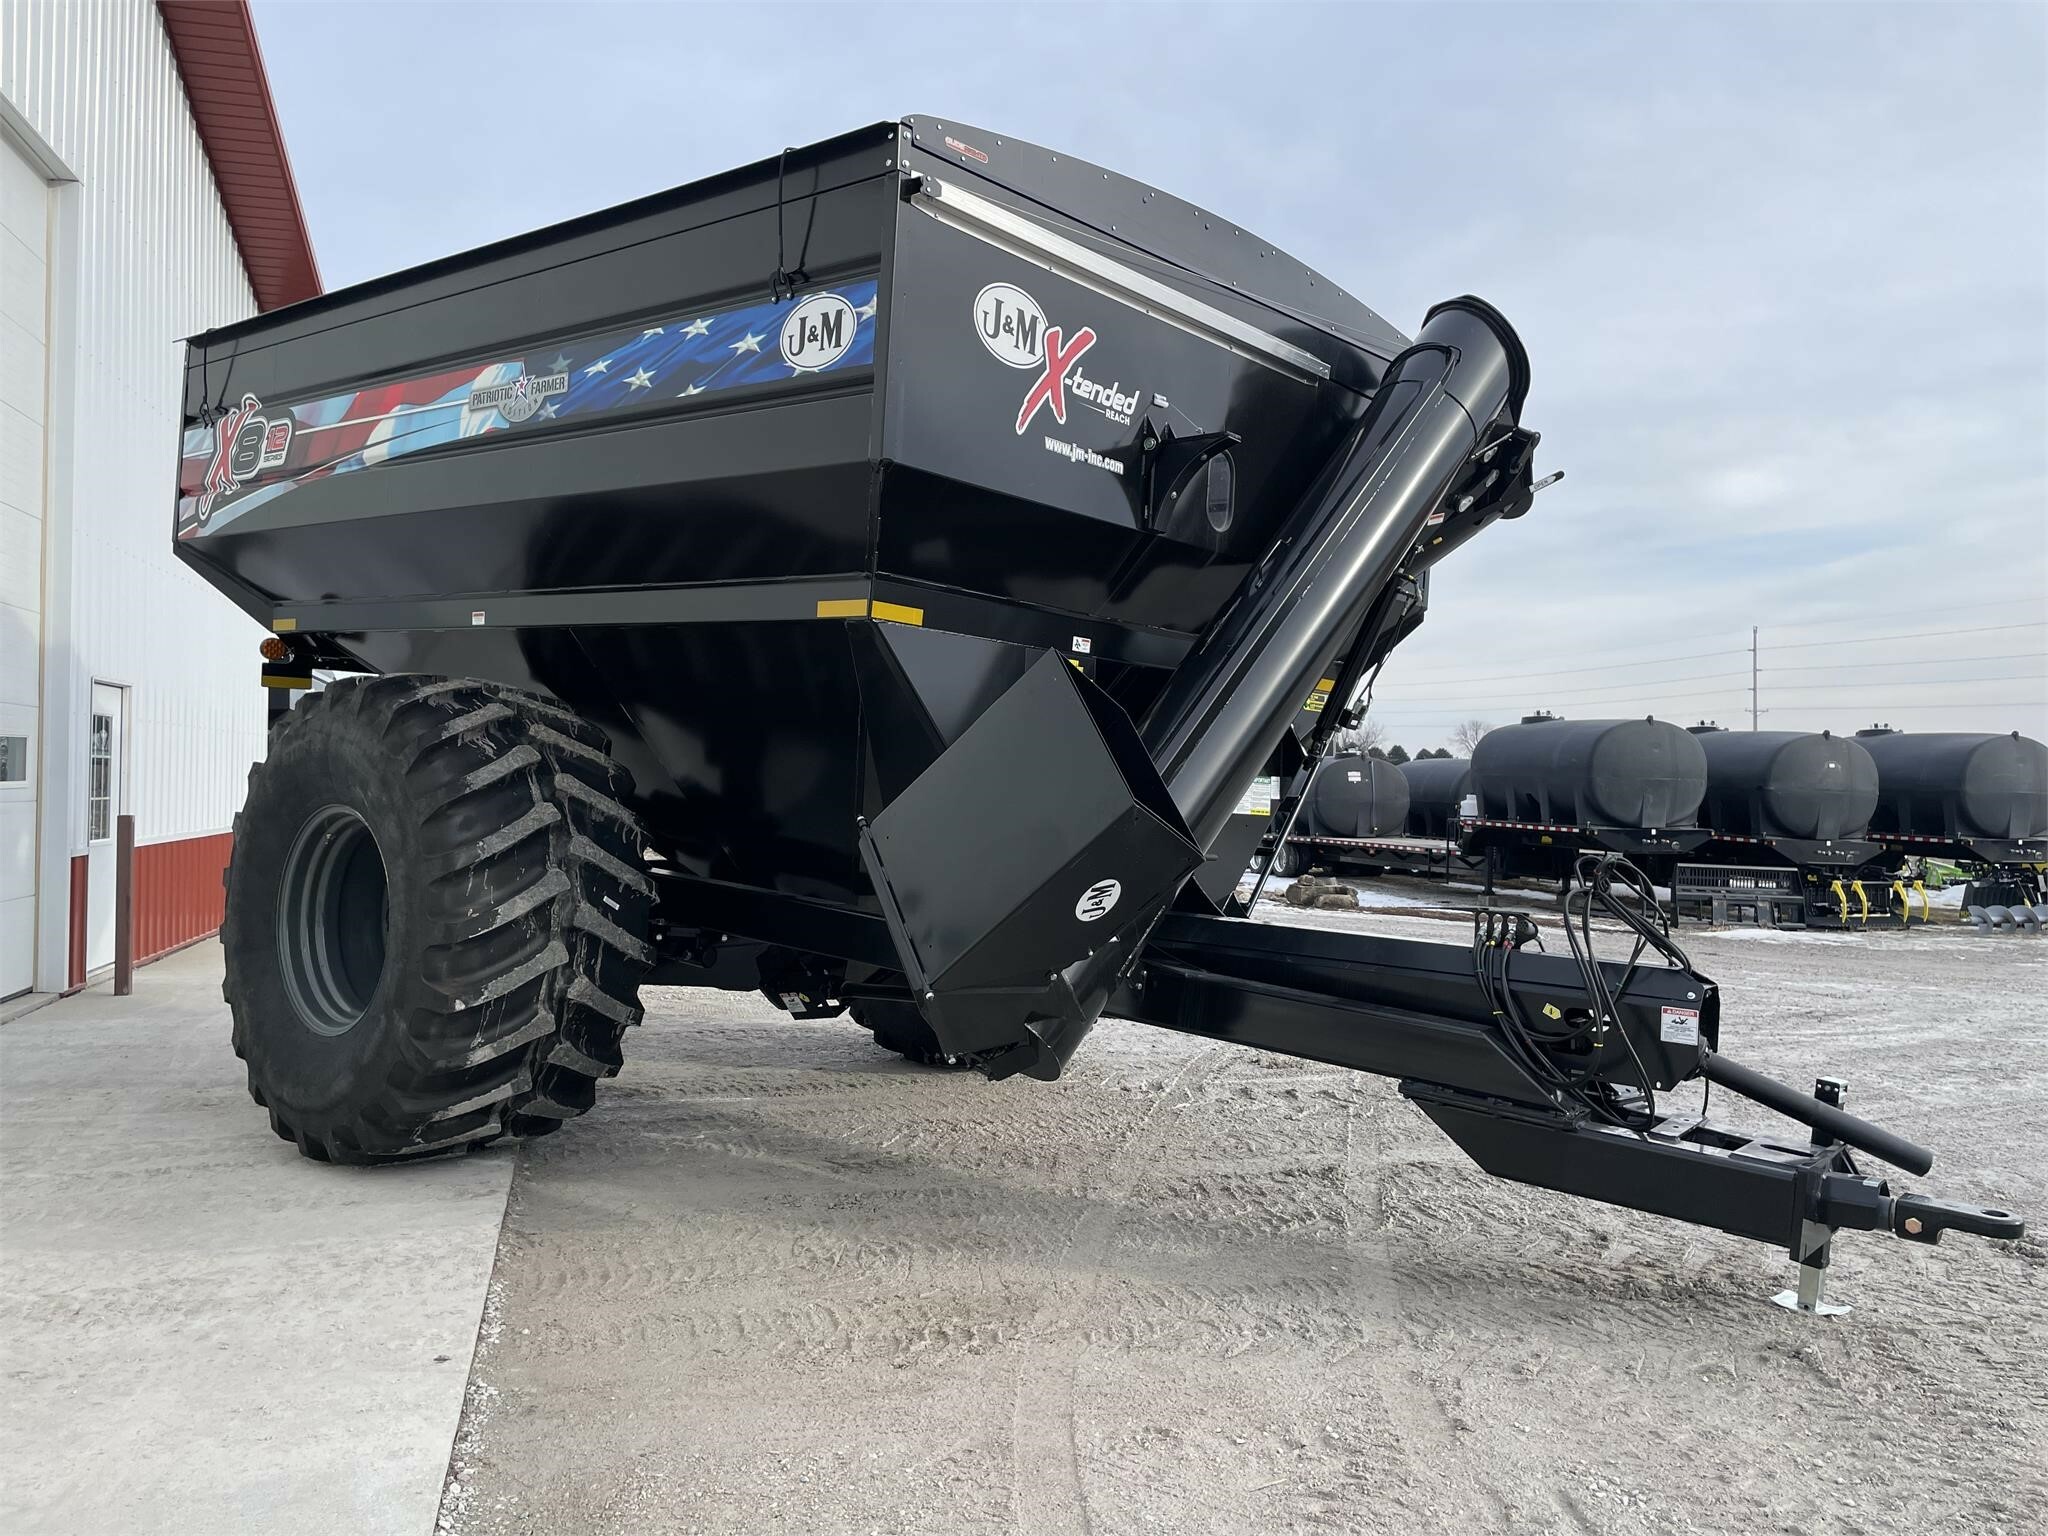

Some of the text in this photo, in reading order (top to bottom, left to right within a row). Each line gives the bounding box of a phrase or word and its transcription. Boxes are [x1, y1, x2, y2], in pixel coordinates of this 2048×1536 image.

[788, 308, 844, 357] J&M
[983, 297, 1039, 357] J&M
[472, 376, 565, 406] PATRIOTIC FARMER
[1105, 408, 1130, 426] REACH
[1044, 436, 1124, 475] www.jm-inc.com
[1533, 480, 1549, 490] OPEN
[1081, 882, 1117, 919] J&M
